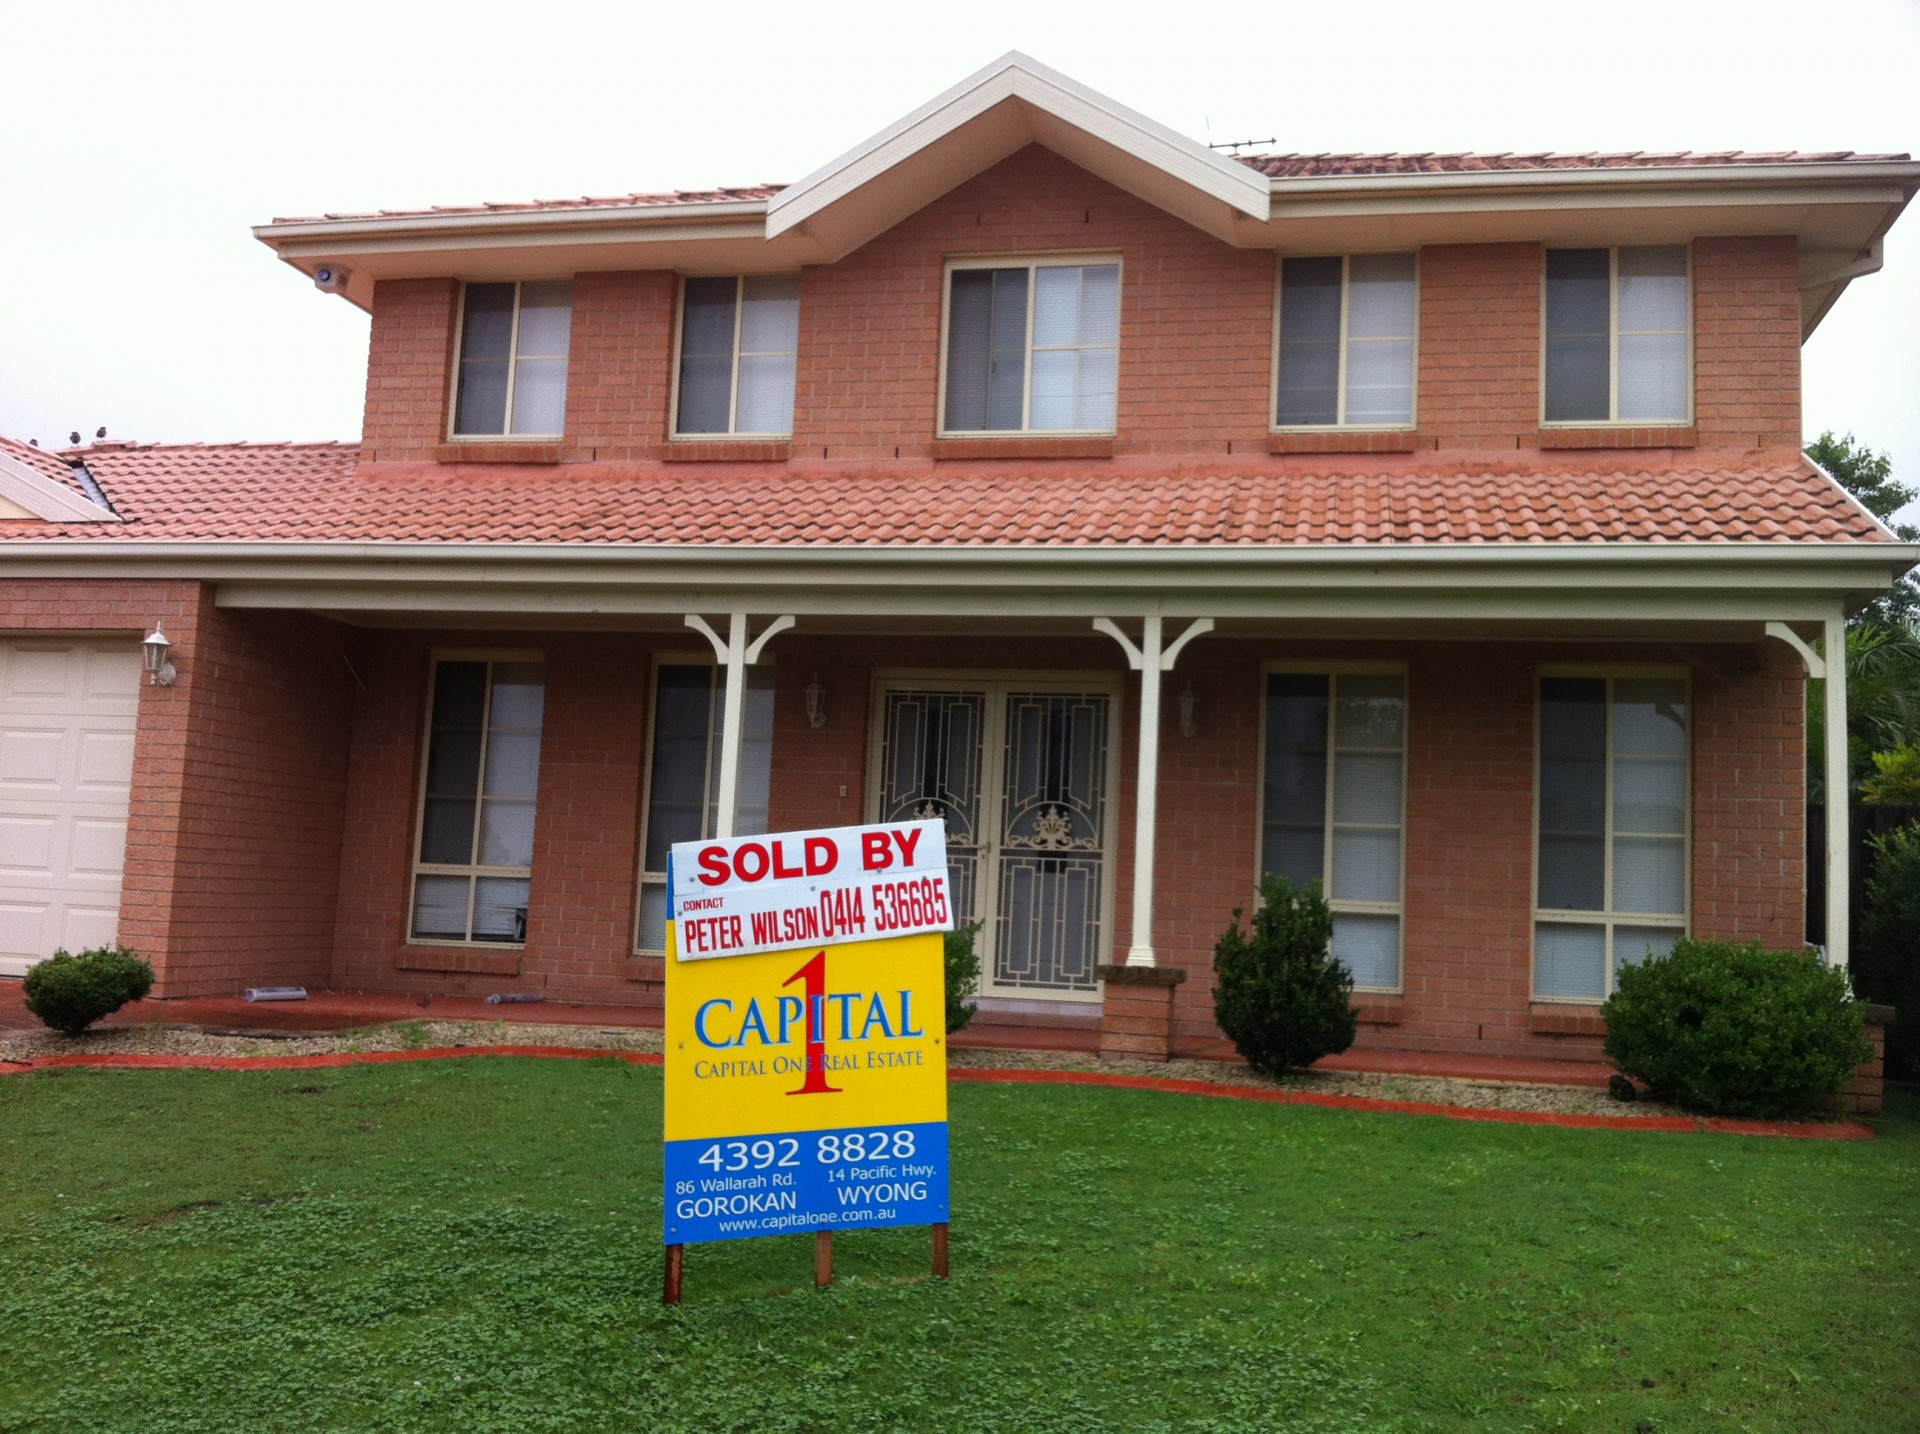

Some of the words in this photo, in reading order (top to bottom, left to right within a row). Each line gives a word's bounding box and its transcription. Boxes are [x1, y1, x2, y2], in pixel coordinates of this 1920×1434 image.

[697, 836, 839, 886] SOLD
[861, 828, 922, 871] BY
[683, 896, 725, 912] CONTACT
[685, 914, 744, 954] PETER
[751, 906, 819, 945] WILSON
[820, 887, 866, 938] 0414
[872, 877, 948, 931] 536685
[694, 990, 925, 1049] CAPITAL
[694, 1060, 768, 1079] CAPITAL
[773, 1055, 813, 1074] ONE
[819, 1053, 860, 1071] REAL
[867, 1050, 924, 1069] ESTATE
[698, 1138, 801, 1172] 4392
[816, 1130, 916, 1164] 8828
[675, 1180, 695, 1195] 86
[701, 1175, 767, 1193] Wallarah
[772, 1172, 797, 1187] Rd.
[827, 1168, 846, 1183] 14
[850, 1165, 897, 1181] Pacific
[901, 1163, 937, 1178] Hwy.
[676, 1191, 797, 1219] GOROKAN
[837, 1181, 928, 1206] WYONG
[718, 1207, 897, 1232] www.capitalone.com.au
